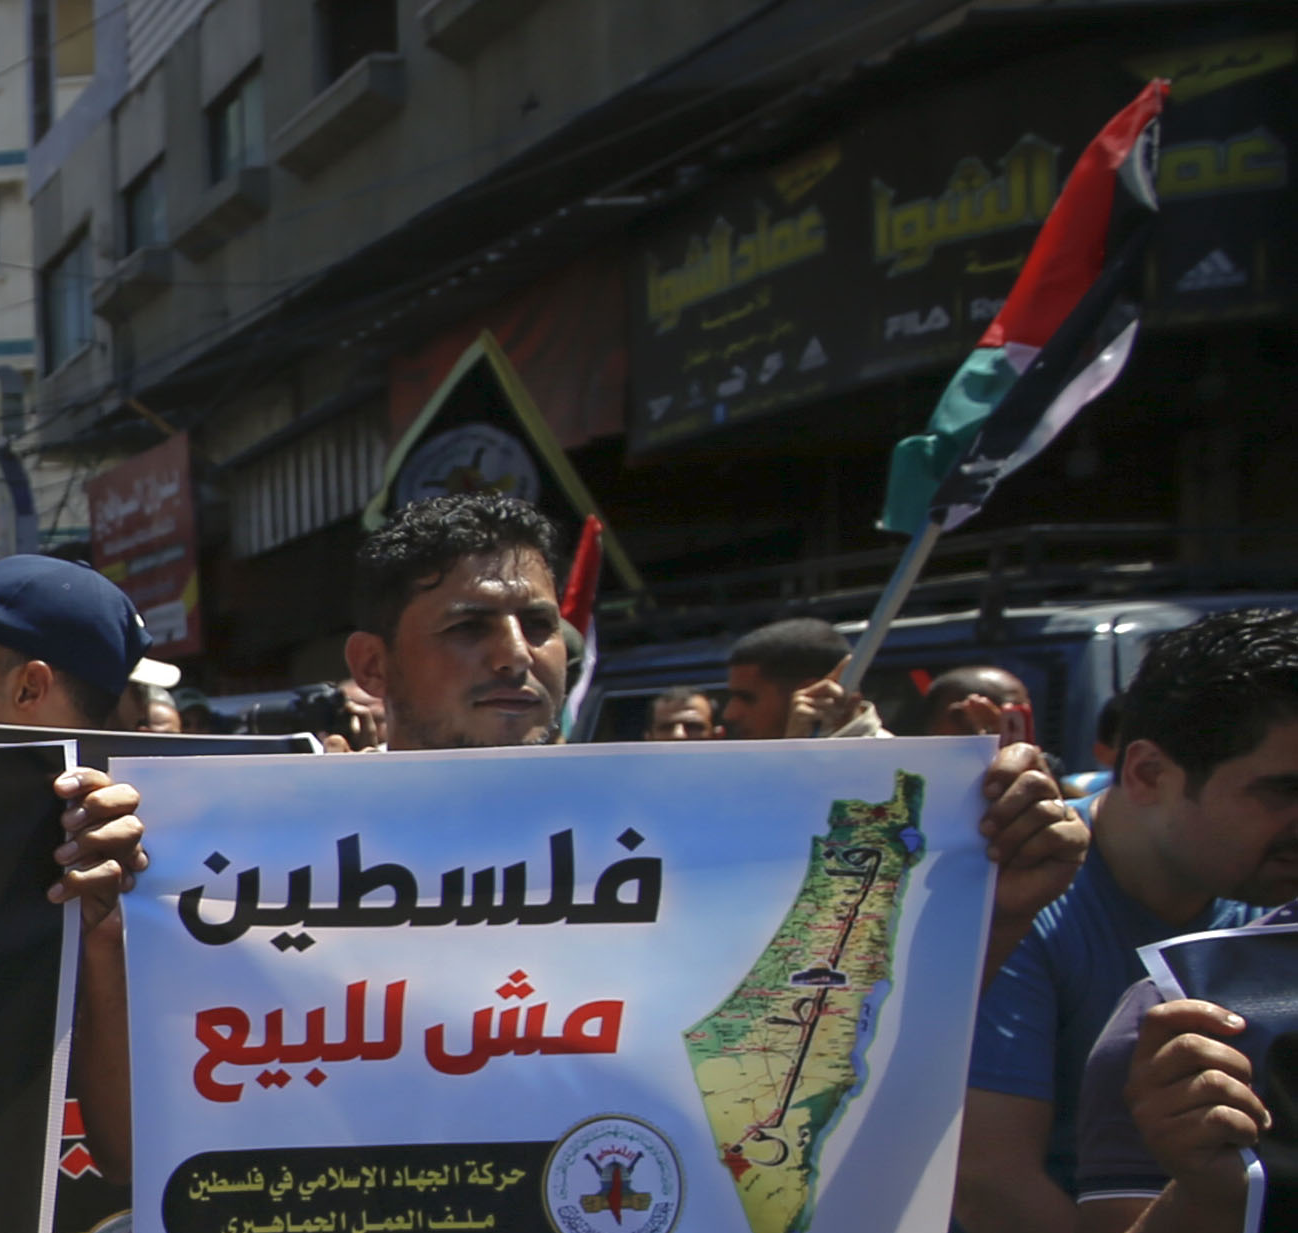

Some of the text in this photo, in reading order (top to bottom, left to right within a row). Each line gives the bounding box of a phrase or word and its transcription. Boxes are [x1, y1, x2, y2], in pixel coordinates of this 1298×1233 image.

[177, 826, 663, 953] فلسطين
[193, 968, 625, 1103] مش للبيع
[188, 1167, 265, 1201] فلسطين
[269, 1165, 294, 1202] في
[298, 1166, 386, 1201] الإسلامي
[392, 1164, 460, 1194] الجهاد
[465, 1160, 527, 1191] حركة
[428, 1206, 495, 1230] ملف
